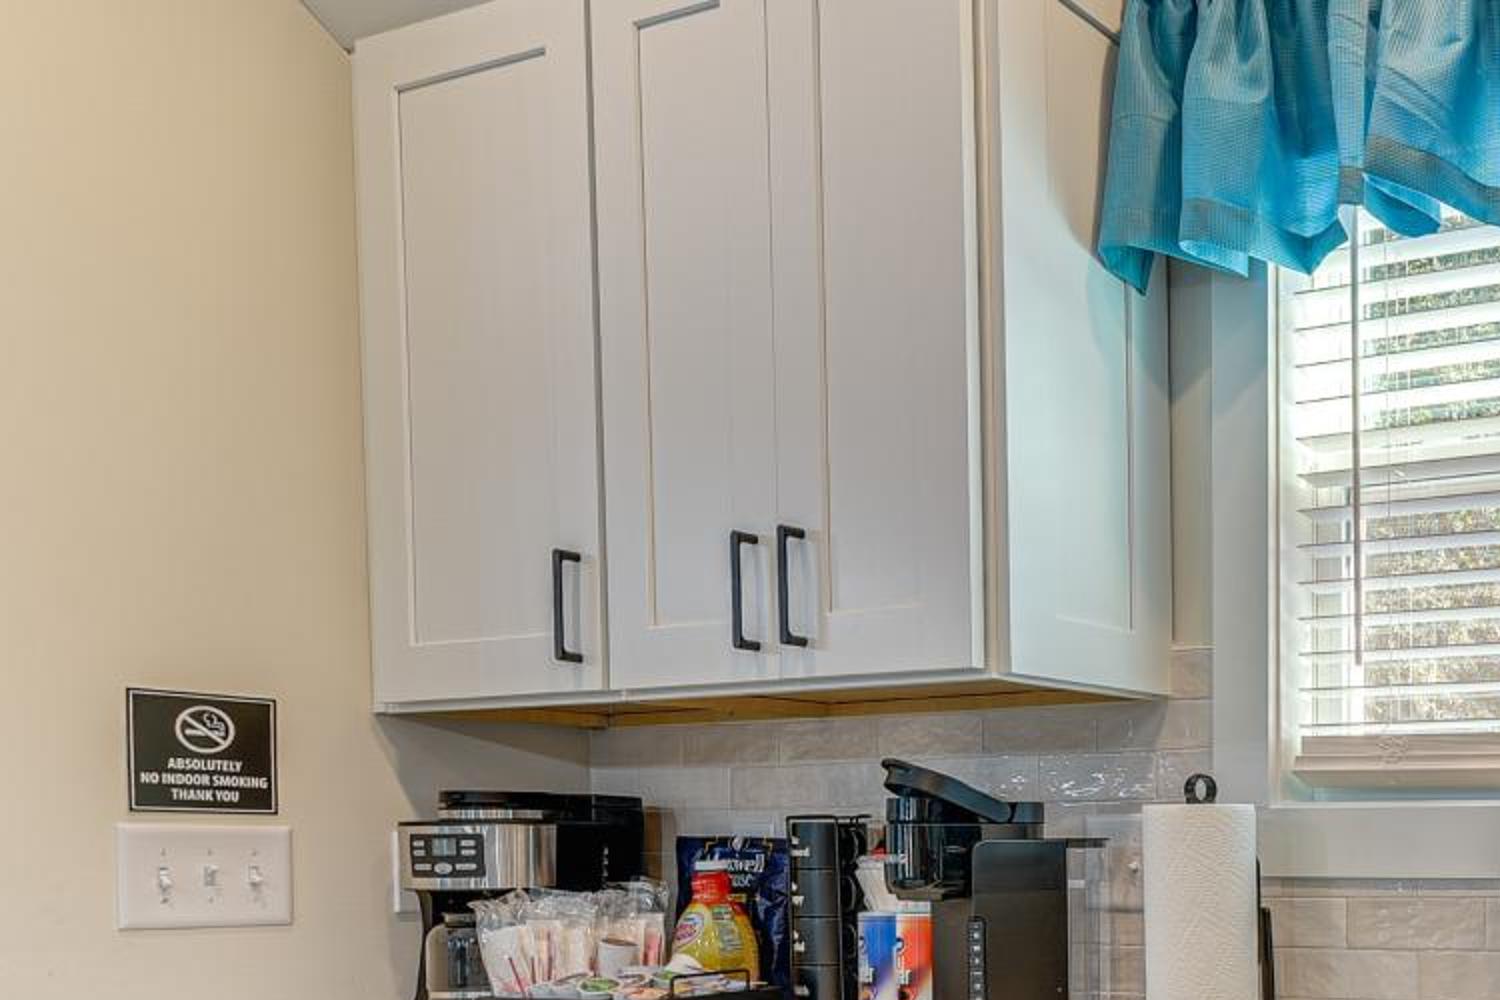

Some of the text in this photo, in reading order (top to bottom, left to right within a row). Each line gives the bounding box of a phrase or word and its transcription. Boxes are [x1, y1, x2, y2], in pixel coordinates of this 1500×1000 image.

[168, 757, 243, 773] ABSOLUTELY
[140, 771, 269, 789] NO INDOOR SMOKING
[171, 788, 240, 802] THANK YOU
